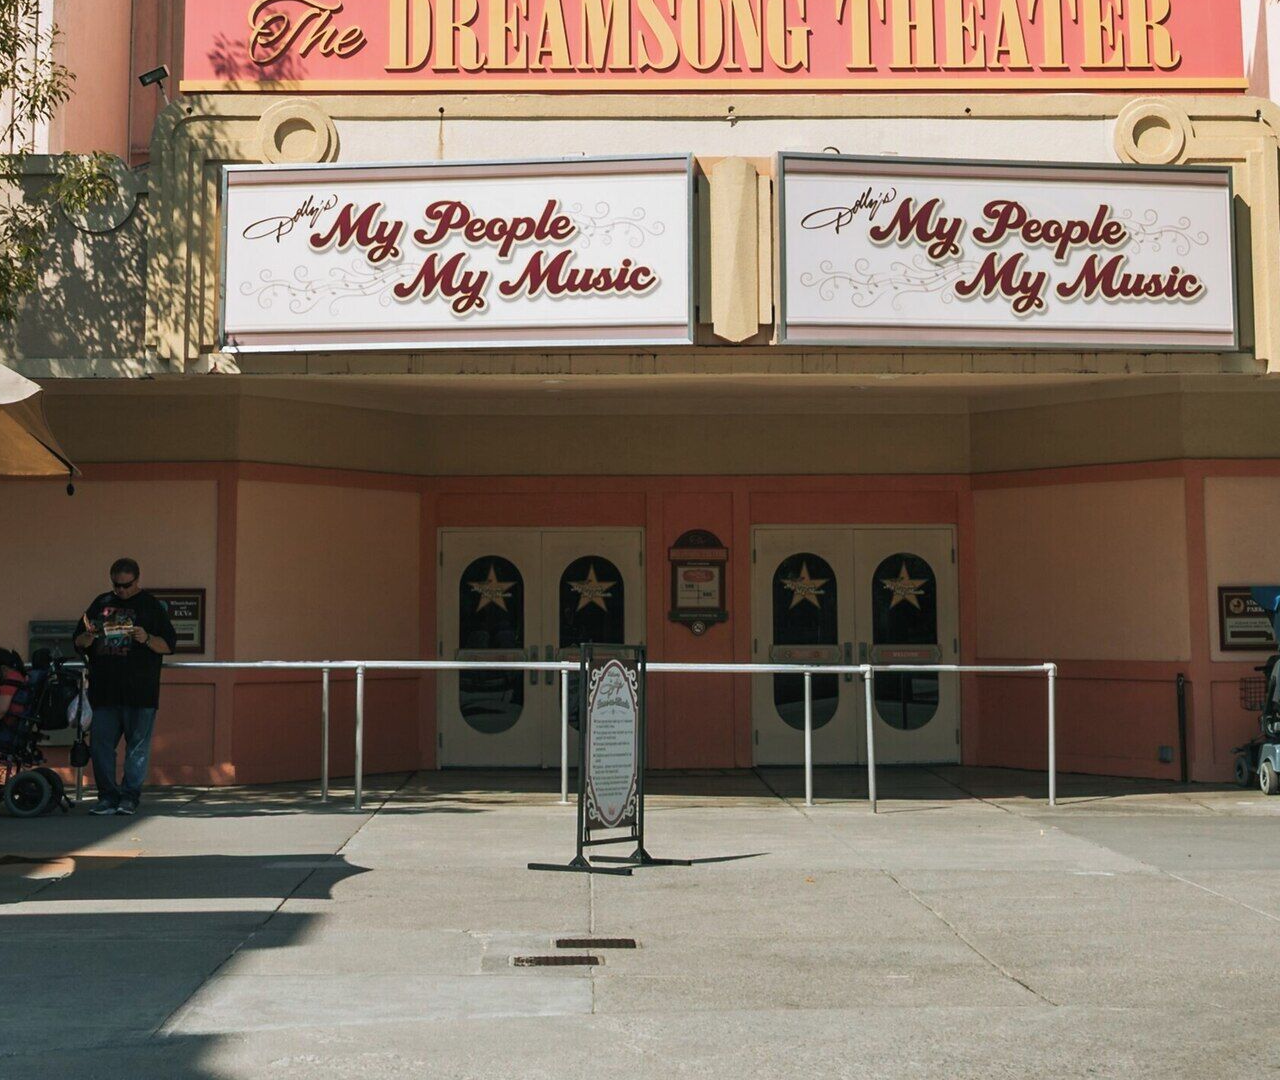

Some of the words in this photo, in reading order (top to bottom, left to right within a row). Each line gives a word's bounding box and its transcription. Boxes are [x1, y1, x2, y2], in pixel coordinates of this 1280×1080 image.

[243, 194, 339, 242] Dolly's
[310, 202, 403, 262] My
[414, 199, 575, 258] People
[801, 186, 896, 234] Dolly's
[870, 197, 961, 258] My
[972, 199, 1127, 259] People
[394, 252, 486, 312] My
[500, 250, 656, 295] Music
[956, 252, 1045, 313] My
[1059, 254, 1202, 300] Music
